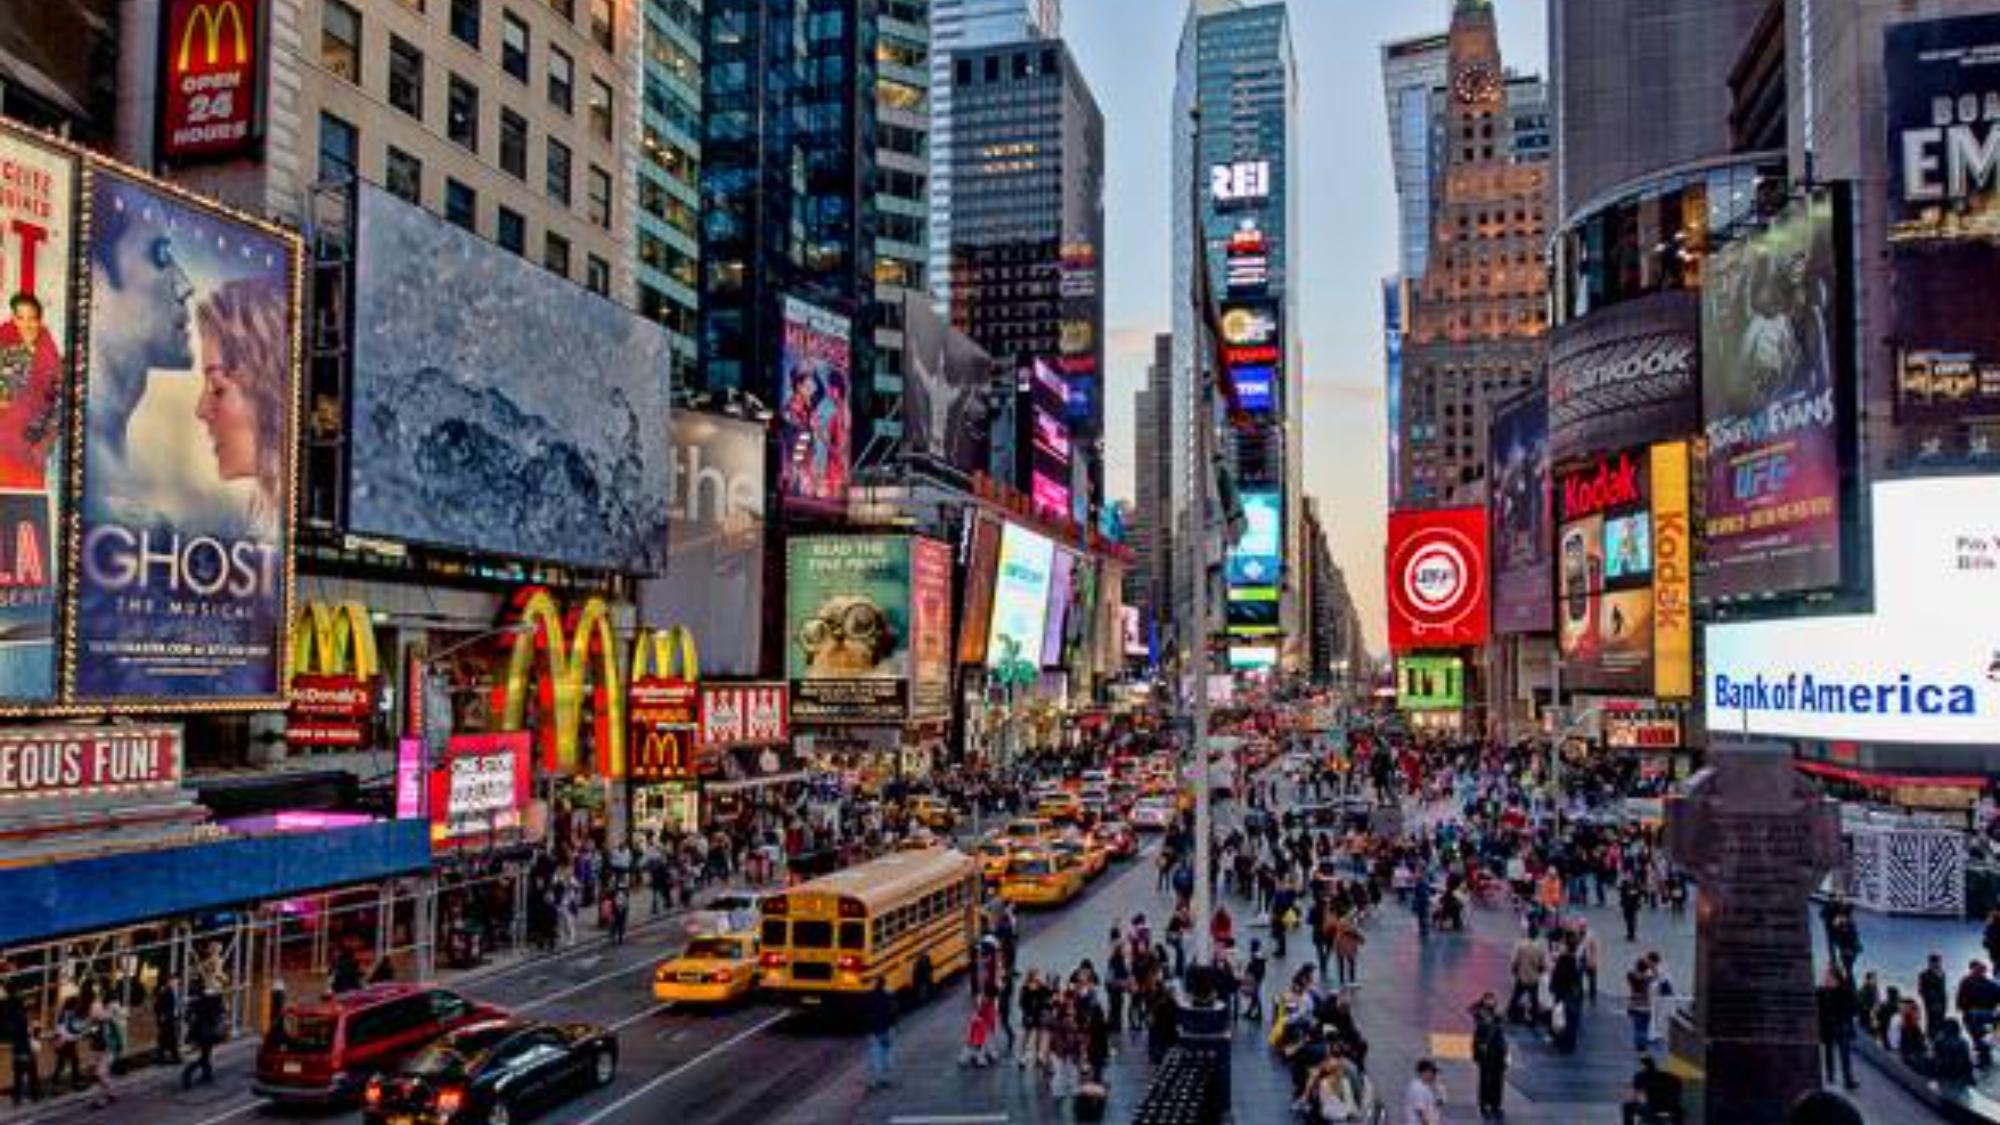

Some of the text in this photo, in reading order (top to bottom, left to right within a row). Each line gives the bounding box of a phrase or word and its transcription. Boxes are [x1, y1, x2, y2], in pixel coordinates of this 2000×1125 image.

[181, 72, 240, 93] OPEN
[187, 91, 234, 121] 24
[174, 121, 247, 145] HOURS
[1565, 452, 1639, 520] Kodak
[83, 524, 277, 598] GHOST
[1655, 511, 1687, 629] Kodak
[115, 597, 253, 618] THE MUSICAL
[1714, 673, 1977, 714] Bank of America
[2, 738, 160, 788] EOUS FUN!
